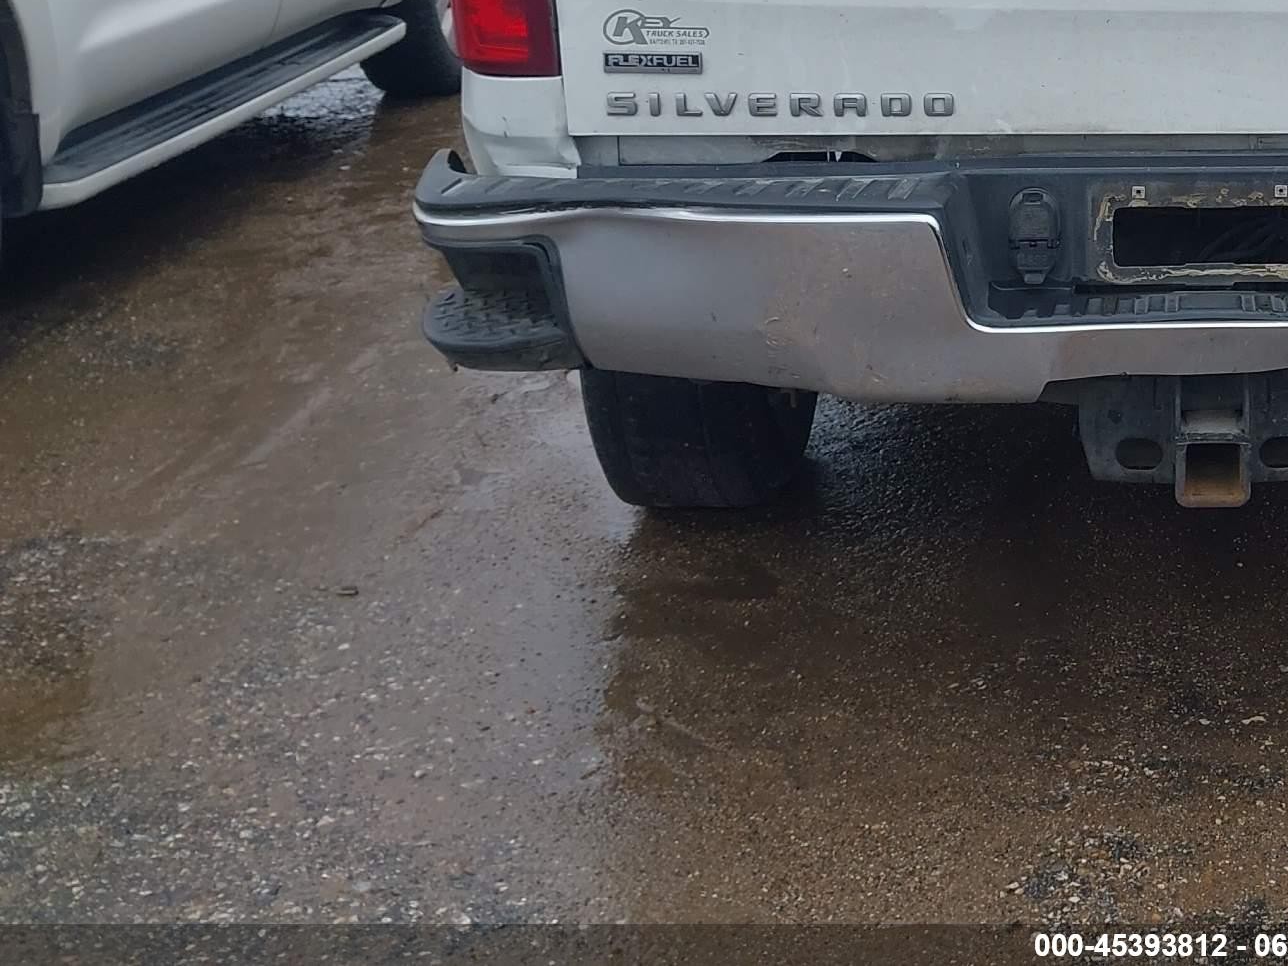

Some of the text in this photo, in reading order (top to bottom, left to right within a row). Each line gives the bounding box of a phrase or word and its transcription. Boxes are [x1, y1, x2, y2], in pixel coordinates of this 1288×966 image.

[612, 16, 681, 45] KEY
[646, 30, 705, 38] TRUCK SALES
[607, 54, 699, 68] FLEXFUEL
[606, 91, 956, 118] SILVERADO
